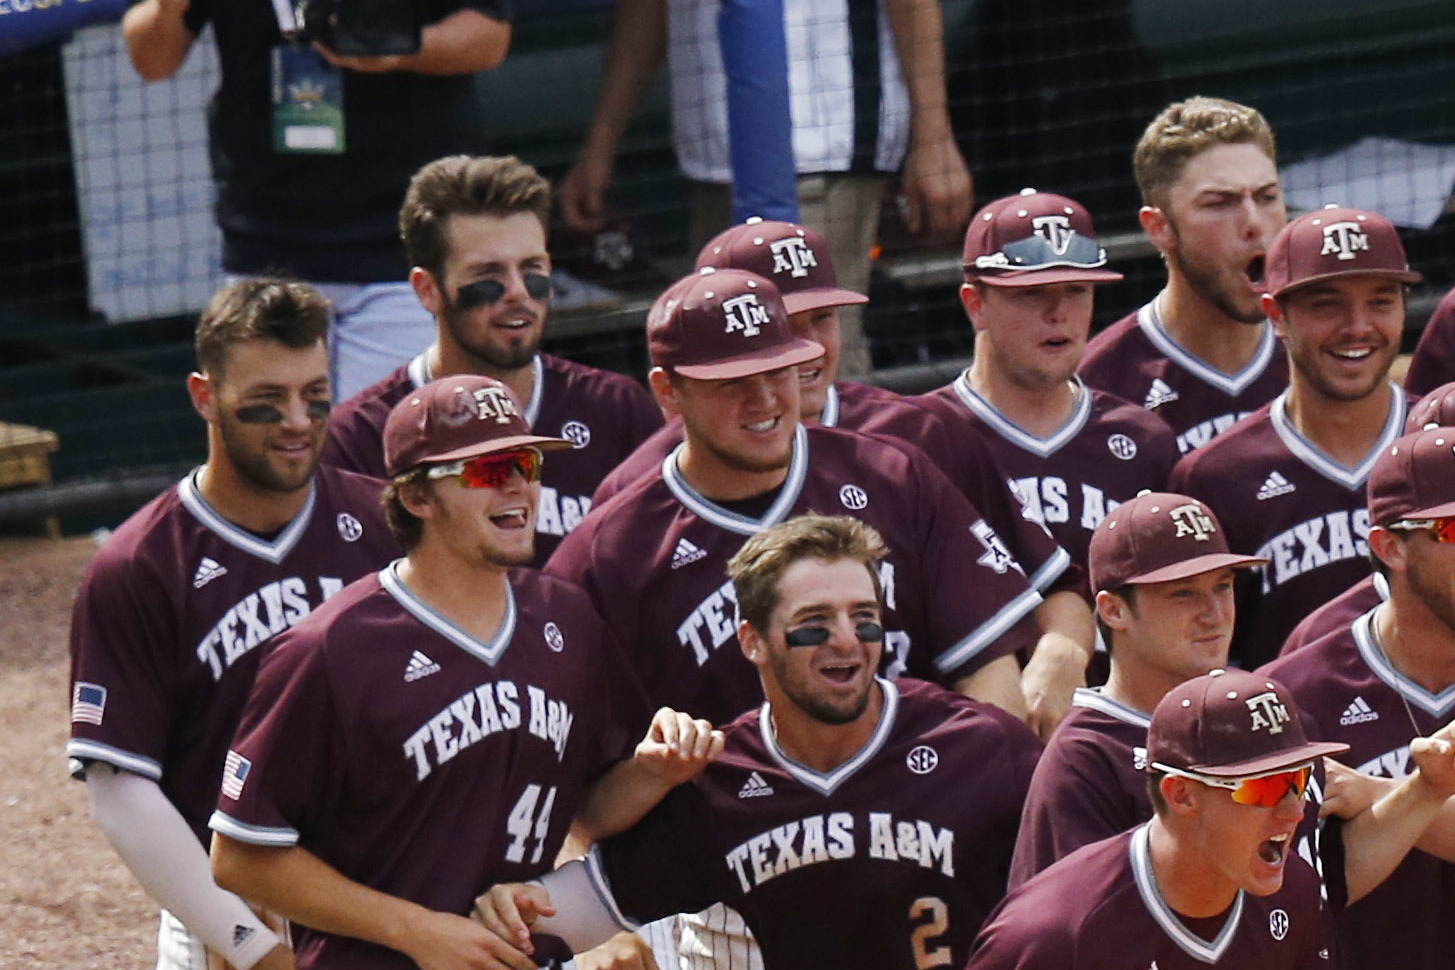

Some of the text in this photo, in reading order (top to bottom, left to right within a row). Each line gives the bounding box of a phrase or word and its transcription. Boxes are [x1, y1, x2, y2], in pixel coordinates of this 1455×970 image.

[402, 680, 522, 783] TEXAS
[906, 746, 939, 774] SEC
[725, 812, 955, 894] TEXAS A&M
